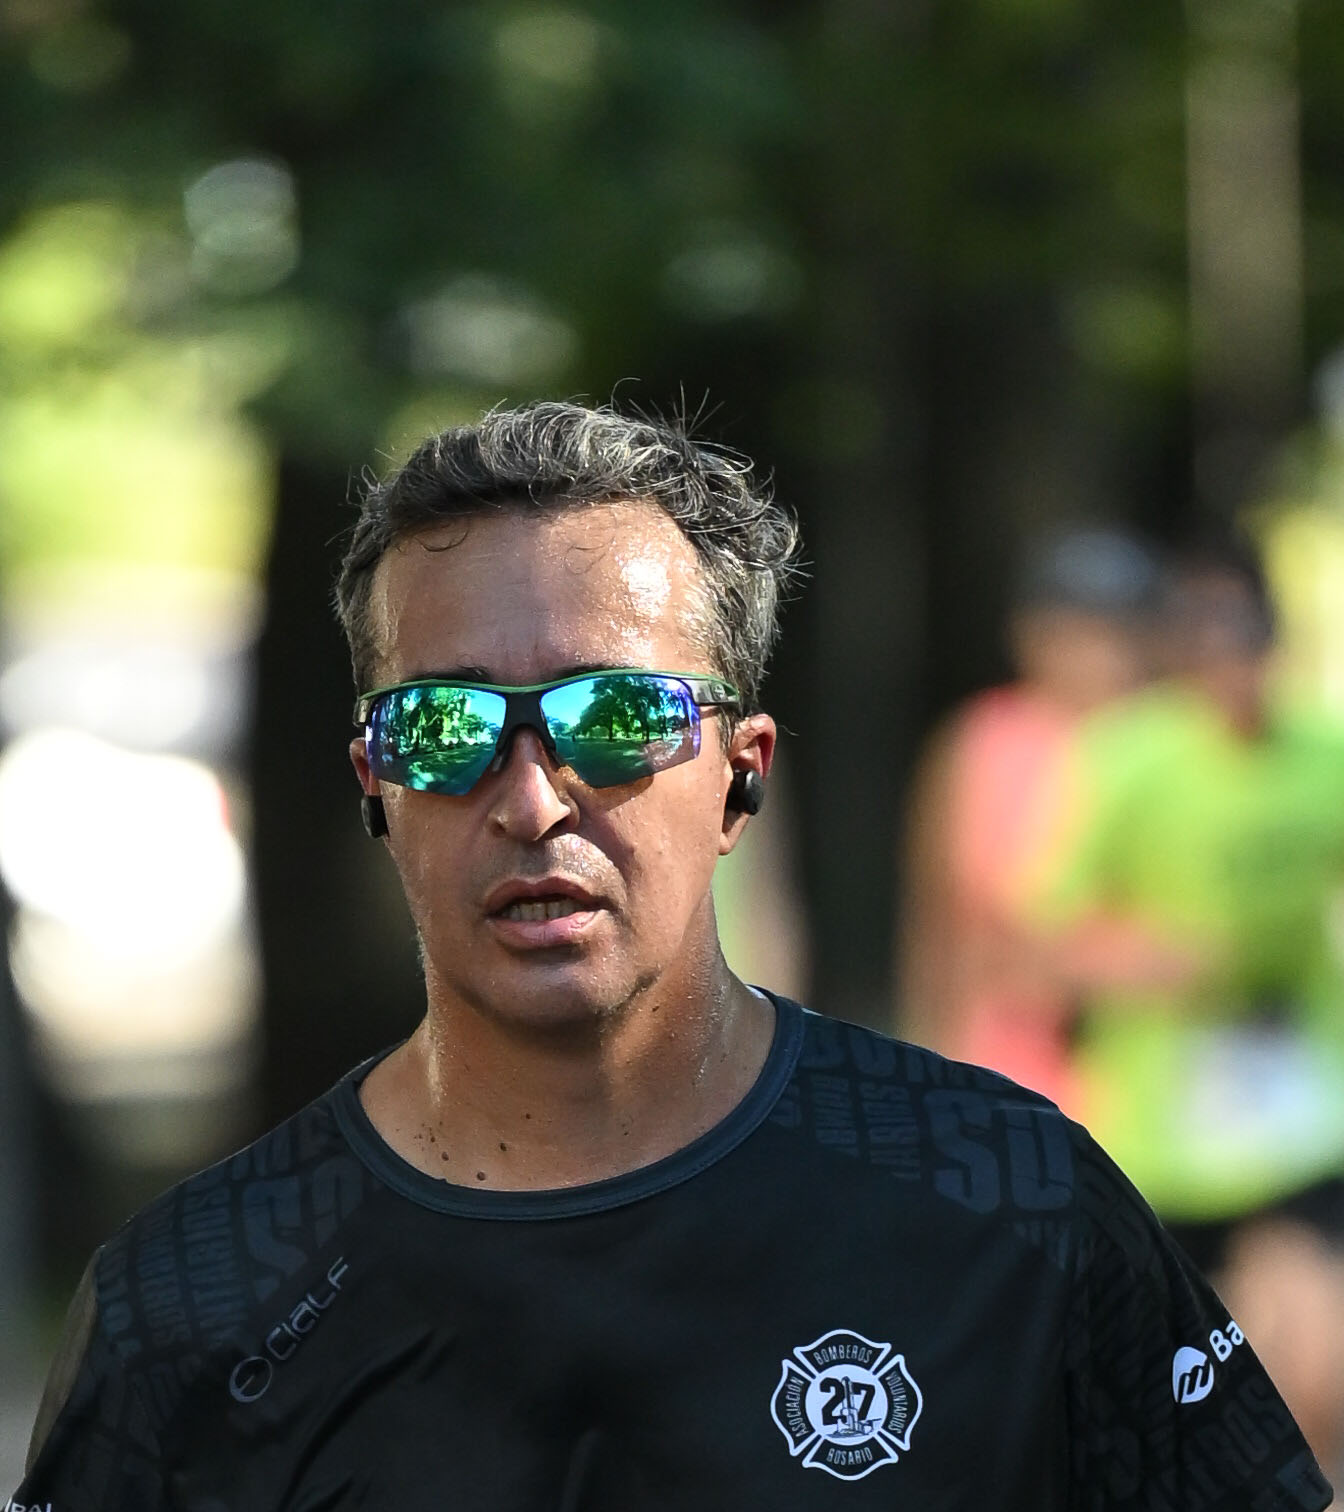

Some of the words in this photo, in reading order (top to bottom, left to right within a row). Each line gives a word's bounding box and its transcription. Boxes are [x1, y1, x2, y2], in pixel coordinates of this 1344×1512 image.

[813, 1344, 873, 1366] BOMBEROS
[819, 1376, 876, 1426] 27
[825, 1447, 873, 1466] ROSARIO
